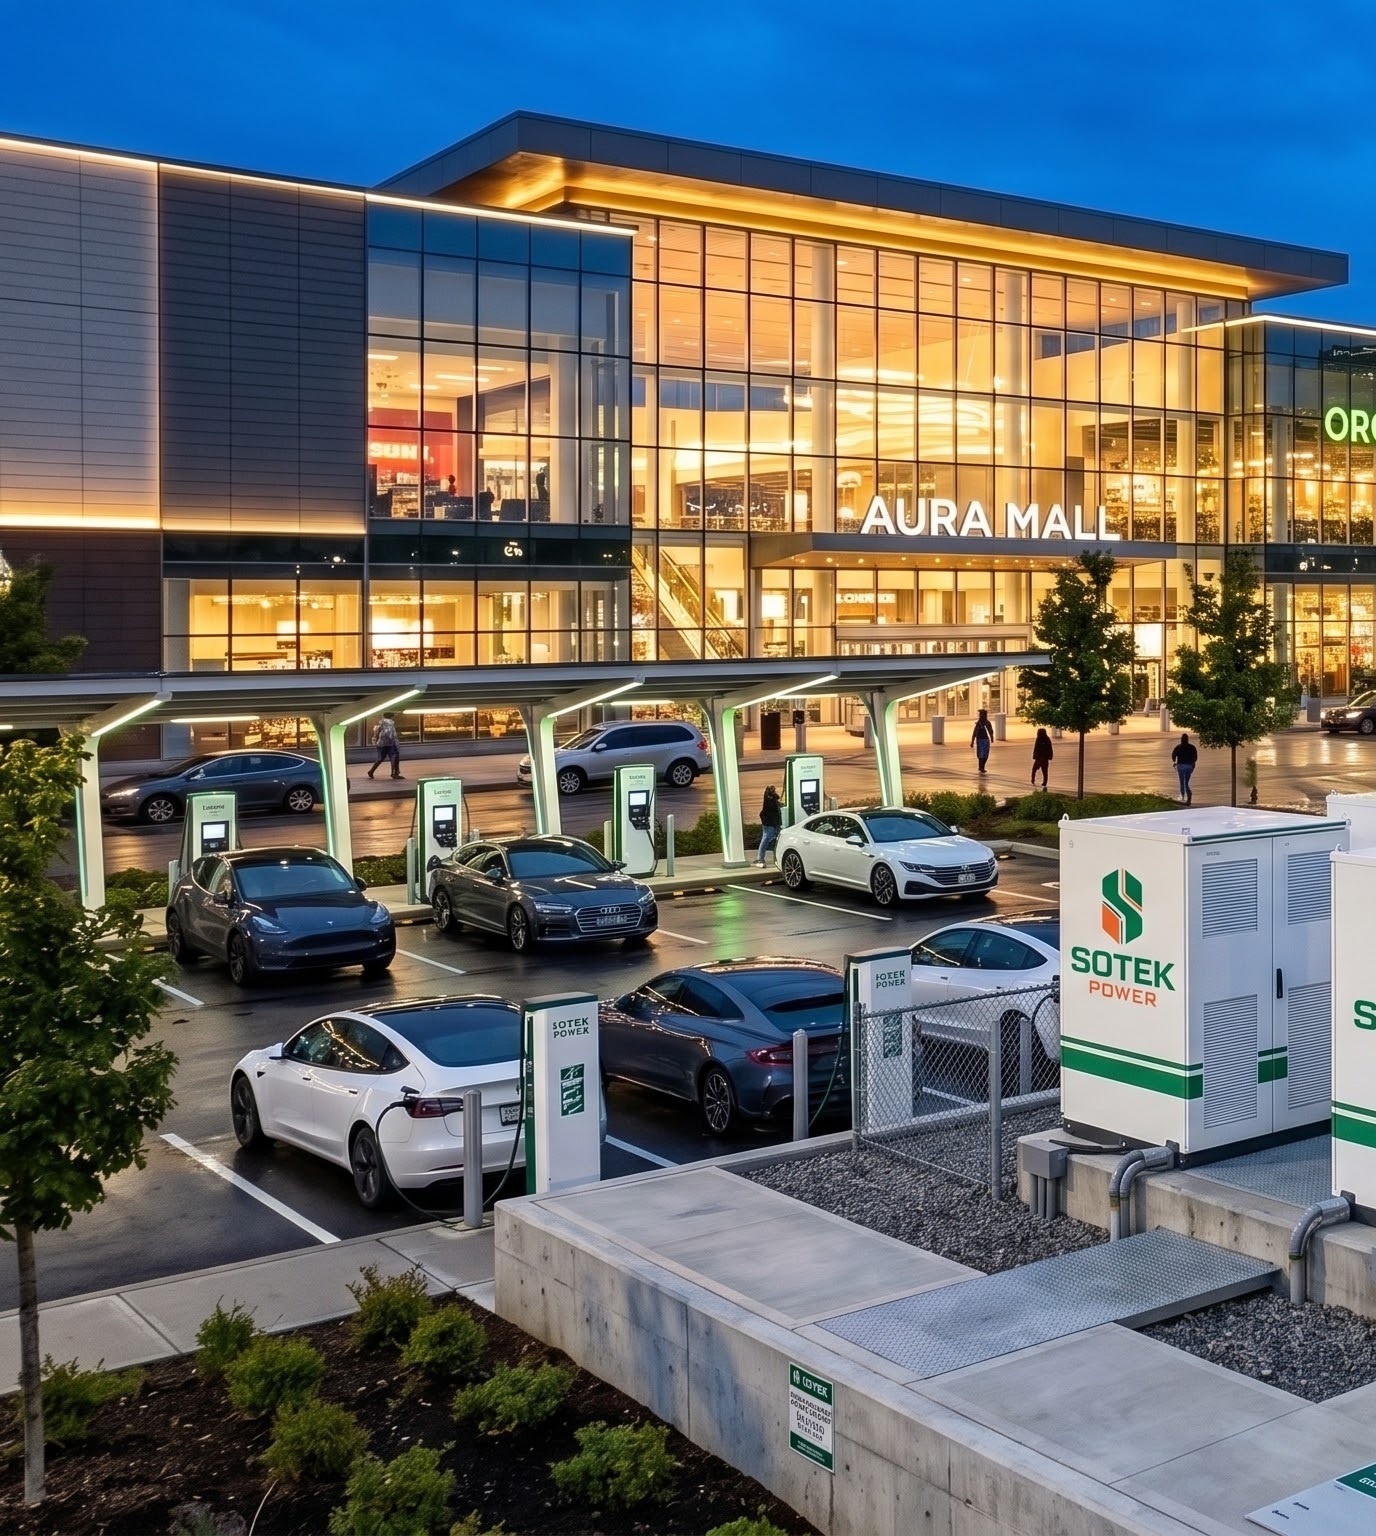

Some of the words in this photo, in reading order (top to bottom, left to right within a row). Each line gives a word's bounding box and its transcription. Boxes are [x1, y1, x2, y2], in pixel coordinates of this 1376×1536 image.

[860, 495, 993, 537] AURA
[1005, 502, 1121, 541] MALL
[1071, 946, 1176, 992] SOTEK
[1089, 979, 1157, 1008] POWER
[552, 1016, 590, 1031] SOTEK
